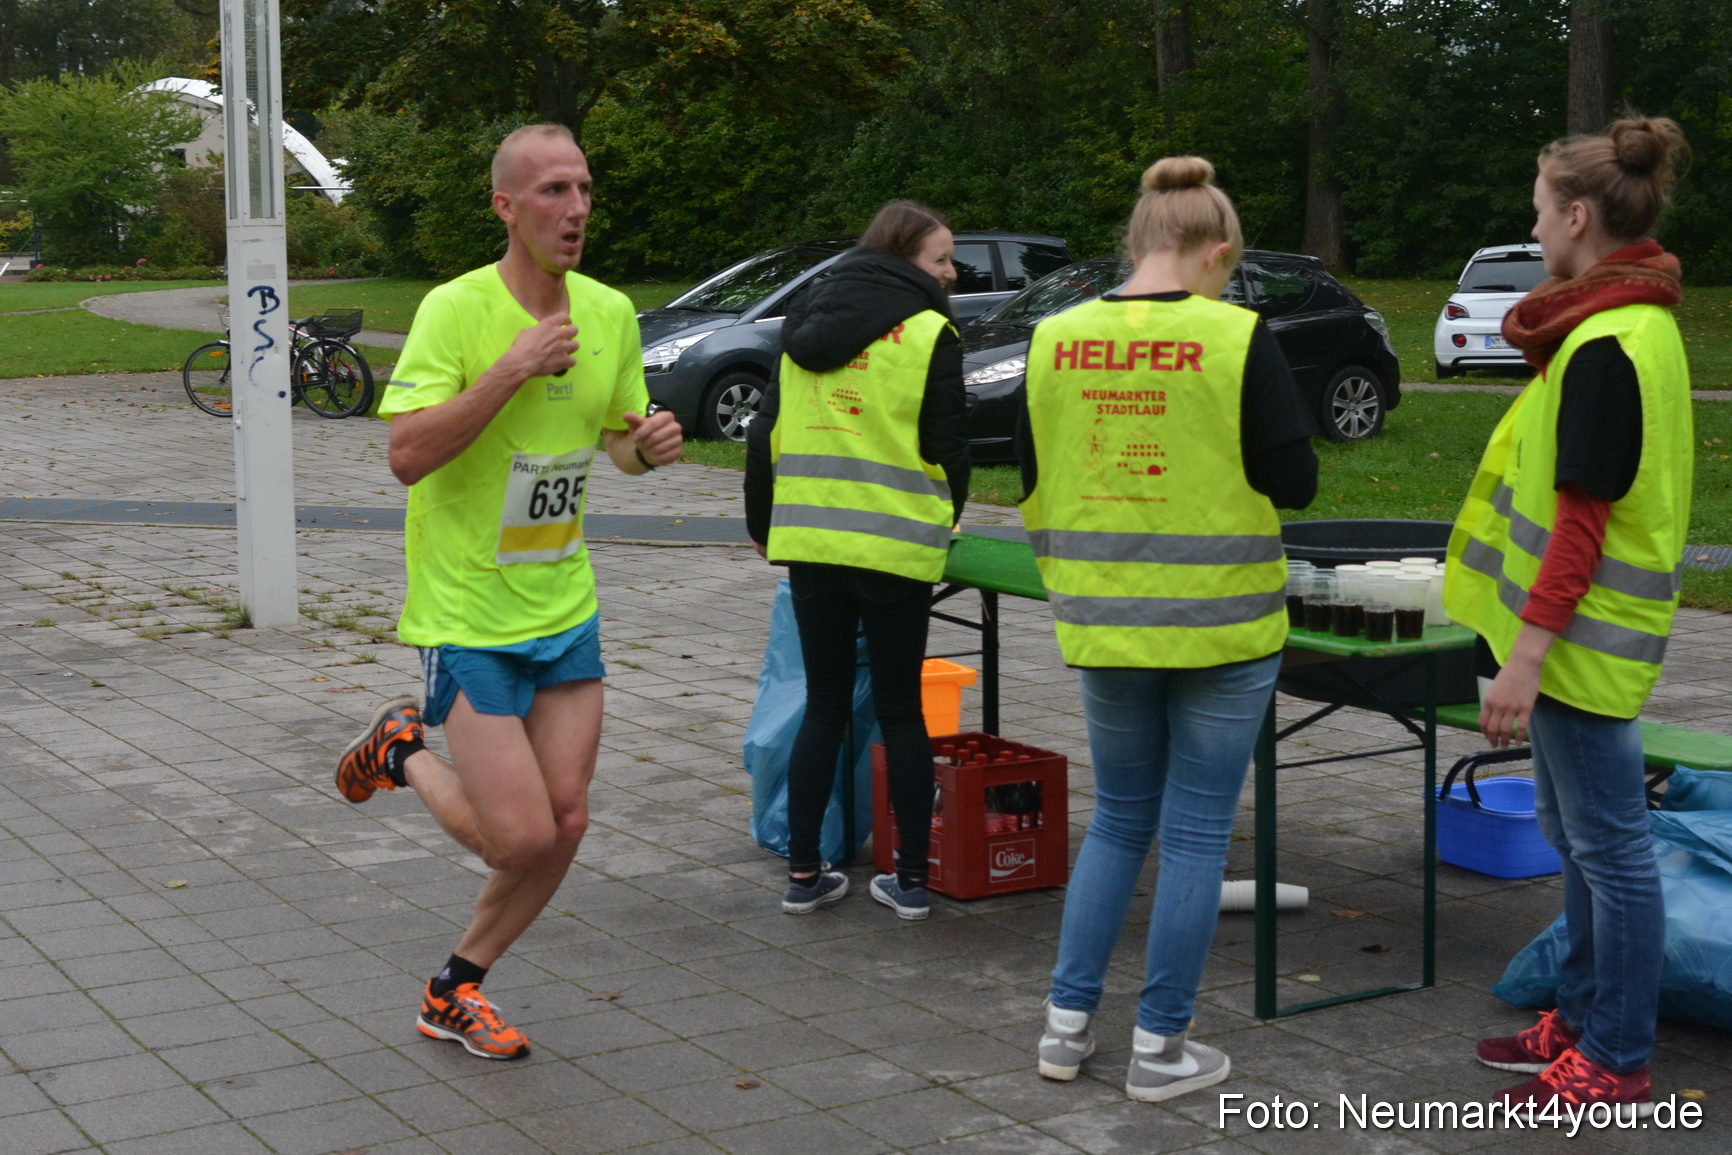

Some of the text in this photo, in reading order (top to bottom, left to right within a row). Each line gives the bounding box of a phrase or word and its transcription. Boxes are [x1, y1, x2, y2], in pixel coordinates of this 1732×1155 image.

[1054, 340, 1204, 372] HELFER
[1082, 389, 1167, 402] NEUMARKTER
[1096, 404, 1167, 416] STADTLAUF
[528, 475, 585, 520] 635
[995, 850, 1026, 867] Coke
